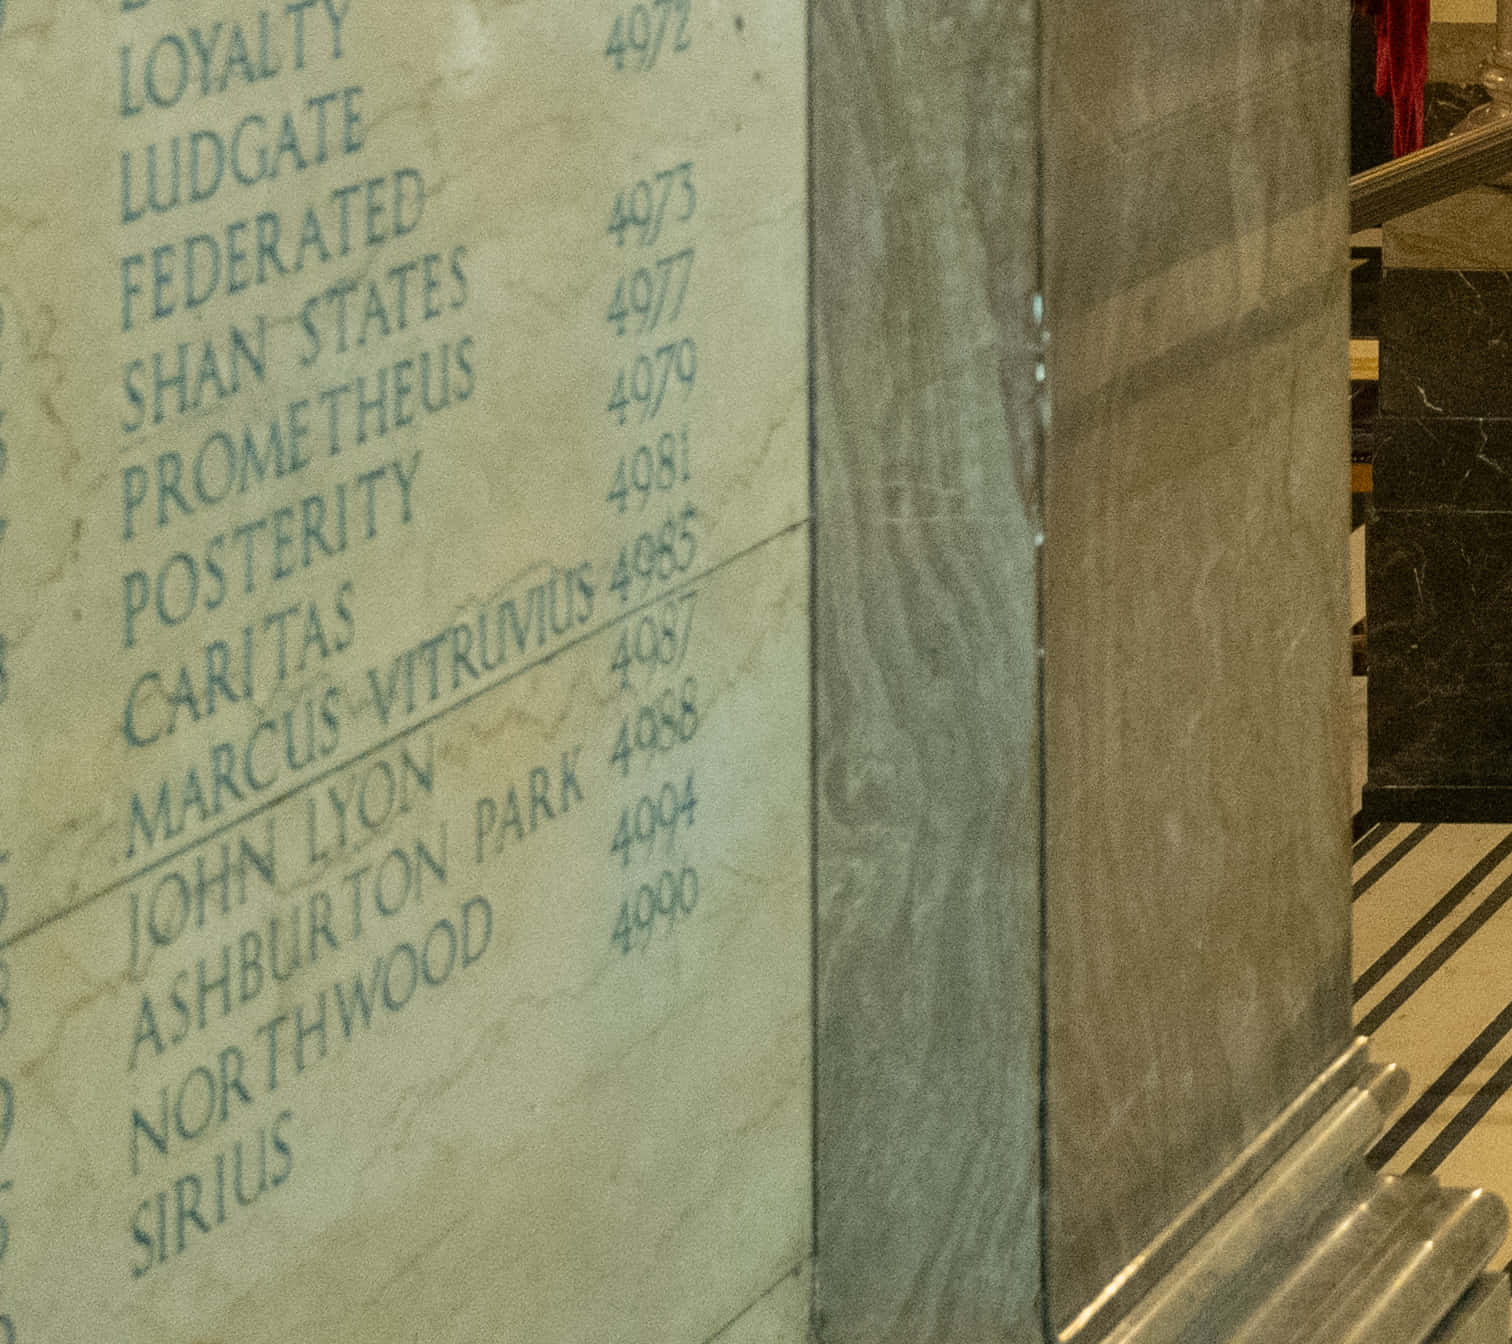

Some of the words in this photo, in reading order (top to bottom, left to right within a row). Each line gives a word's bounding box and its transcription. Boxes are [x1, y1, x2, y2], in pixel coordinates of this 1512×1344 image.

[120, 84, 368, 226] LUDGATE
[120, 167, 428, 333] FEDERATED
[121, 315, 268, 436] SHAN
[297, 245, 471, 369] STATES
[606, 161, 698, 251] 4973
[122, 336, 479, 542] PROMETHEUS
[606, 248, 698, 339] 4977
[122, 450, 425, 651] POSTERITY
[606, 335, 700, 430] 4979
[124, 580, 360, 750] CARITAS
[606, 429, 695, 517] 4981
[126, 688, 343, 860] MARCUS
[364, 562, 598, 725] VITRUVIUS
[608, 506, 700, 606] 4985
[126, 827, 449, 1072] ASHBURTON
[474, 744, 588, 864] PARK
[128, 820, 276, 982] JOHN
[305, 732, 440, 864] LYON
[610, 588, 700, 694] 4987
[129, 893, 496, 1179] NORTHWOOD
[610, 773, 697, 868] 4994
[131, 1108, 294, 1282] SIRIUS
